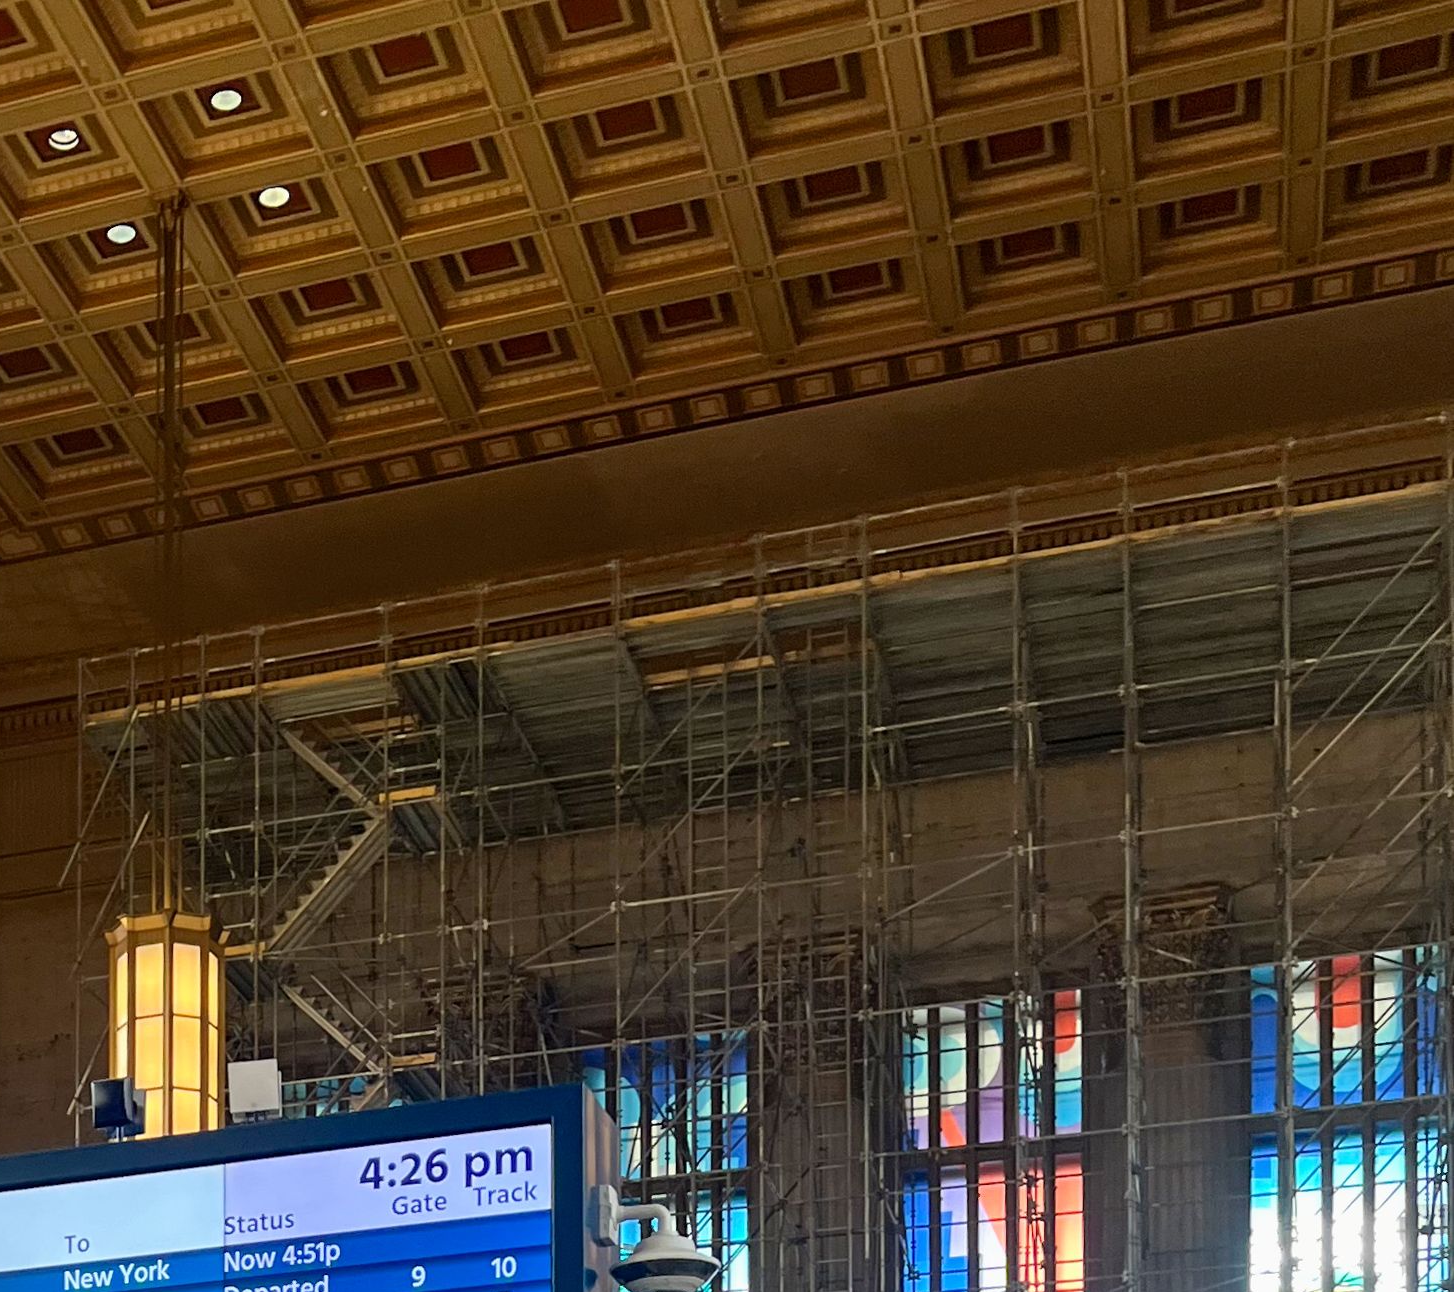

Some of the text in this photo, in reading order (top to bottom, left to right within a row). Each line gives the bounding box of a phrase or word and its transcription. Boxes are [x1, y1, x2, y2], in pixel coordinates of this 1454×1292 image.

[359, 1145, 533, 1190] 4:26 pm
[64, 1234, 90, 1254] To
[224, 1213, 295, 1235] Status
[392, 1194, 447, 1215] Gate
[473, 1181, 538, 1206] Track
[63, 1269, 114, 1291] New
[118, 1259, 170, 1284] York
[223, 1250, 276, 1273] Now
[281, 1241, 341, 1267] 4:51p
[411, 1265, 426, 1288] 9
[490, 1255, 517, 1279] 10
